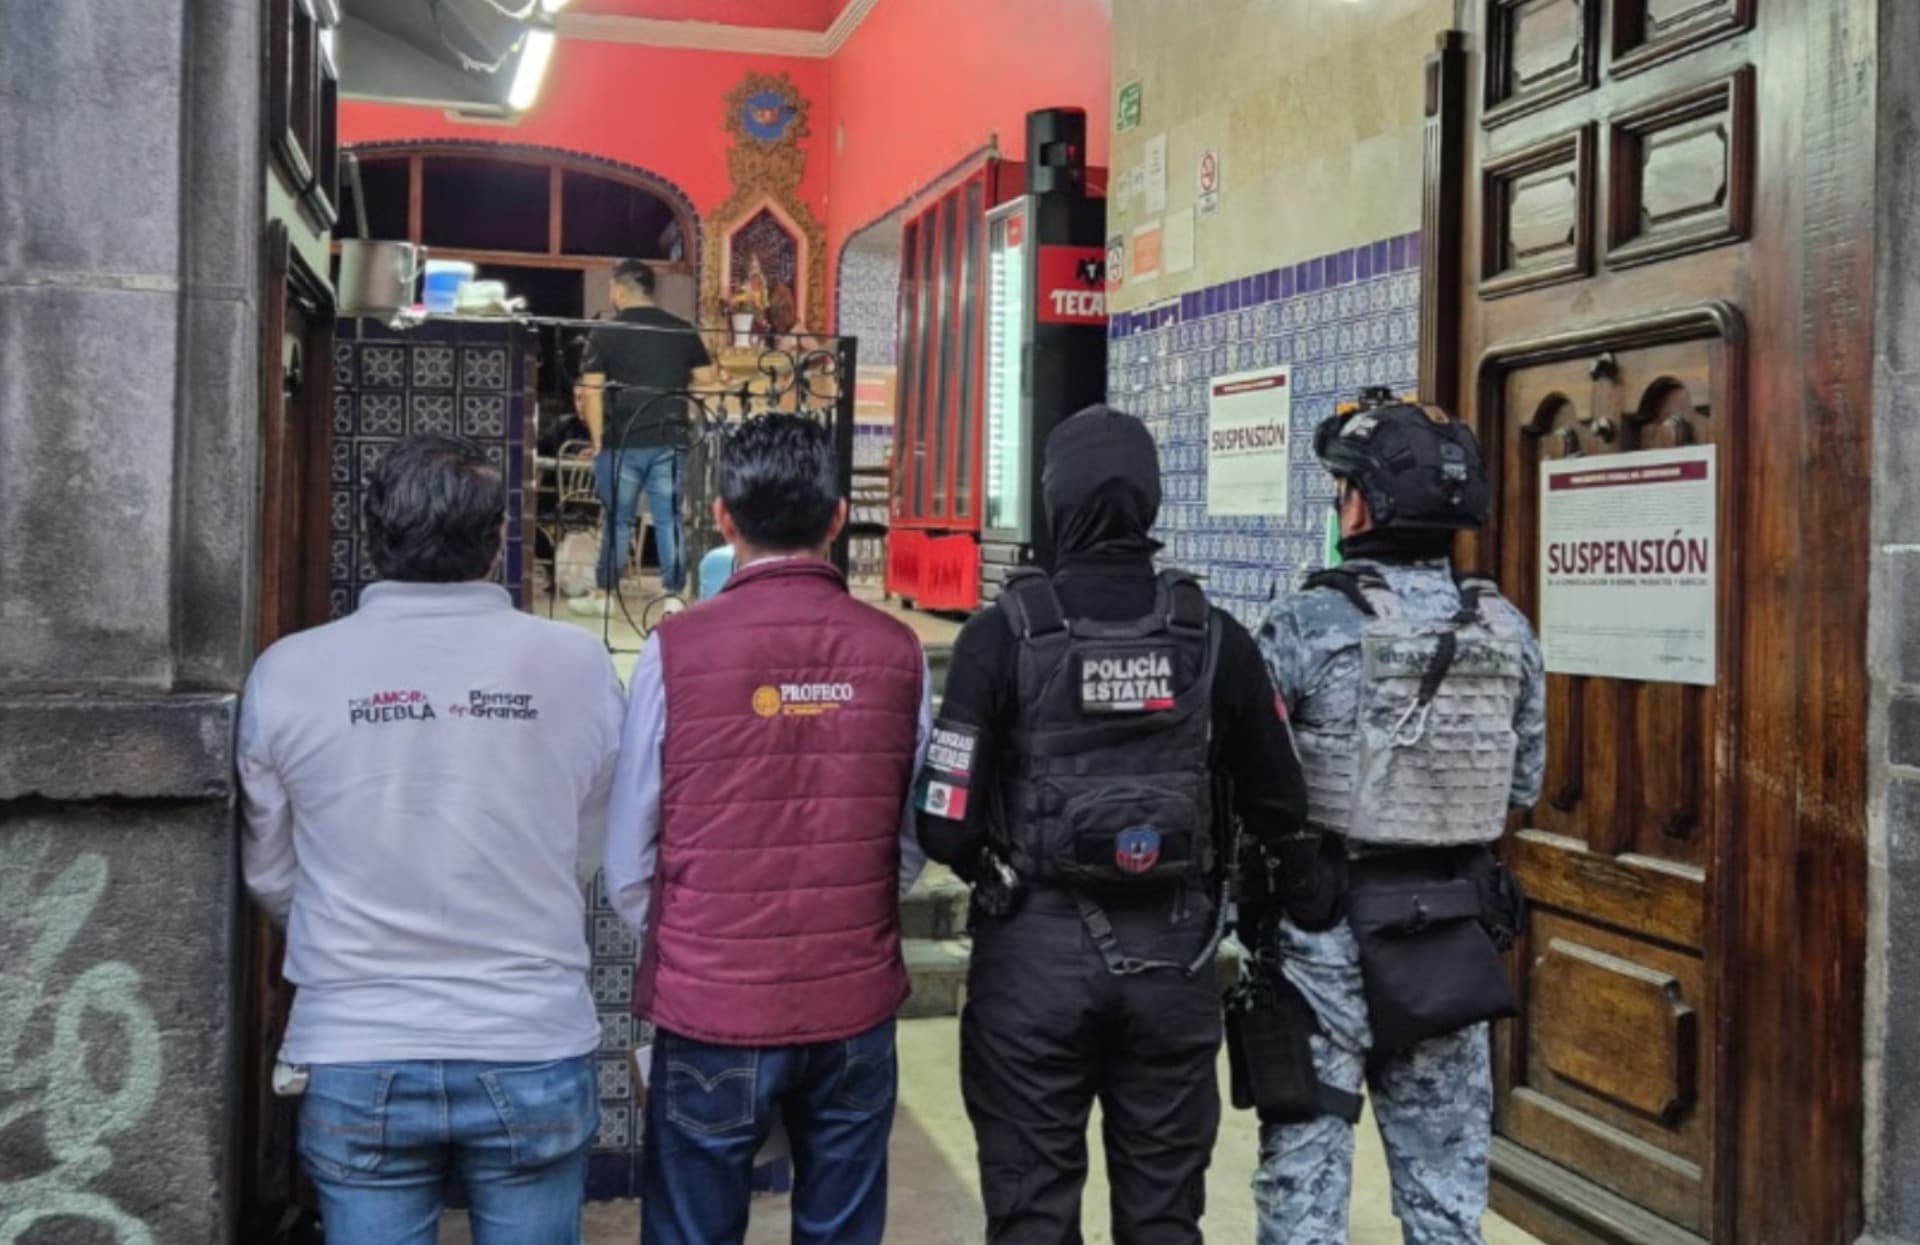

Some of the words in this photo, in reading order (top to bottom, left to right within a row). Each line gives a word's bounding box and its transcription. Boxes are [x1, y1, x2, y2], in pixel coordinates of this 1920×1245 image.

[1050, 289, 1105, 317] TECA
[1212, 418, 1285, 451] SUSPENSIÓN
[1549, 529, 1708, 575] SUSPENSIÓN
[1083, 651, 1172, 680] POLICÍA
[372, 690, 421, 705] AMOR
[469, 690, 533, 706] Pensar
[780, 682, 853, 701] PROFECO
[1083, 679, 1173, 701] ESTATAL
[351, 701, 436, 725] PUEBLA
[470, 704, 539, 720] Grande
